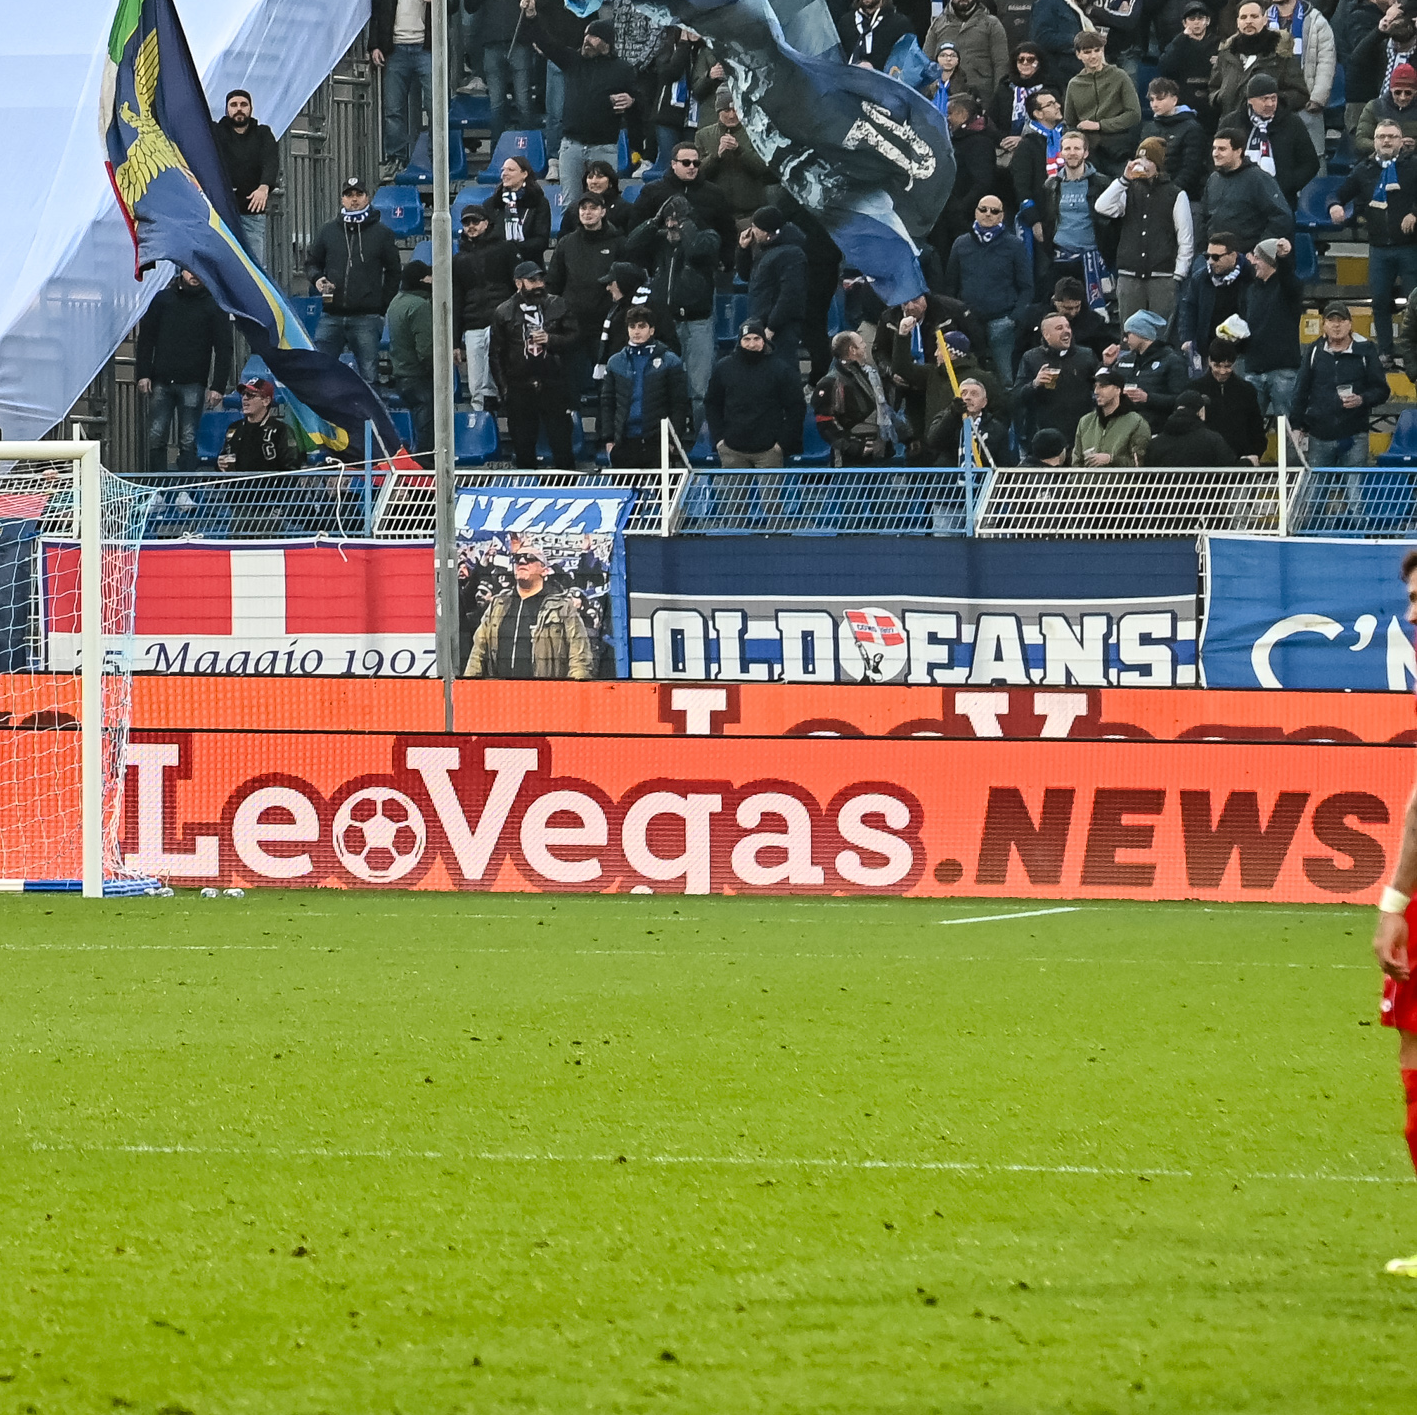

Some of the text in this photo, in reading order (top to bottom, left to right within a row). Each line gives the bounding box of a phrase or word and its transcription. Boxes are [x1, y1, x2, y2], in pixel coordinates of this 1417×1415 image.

[144, 638, 325, 676] Maggio
[342, 646, 437, 677] 1907
[652, 607, 1177, 688] OLD FANS
